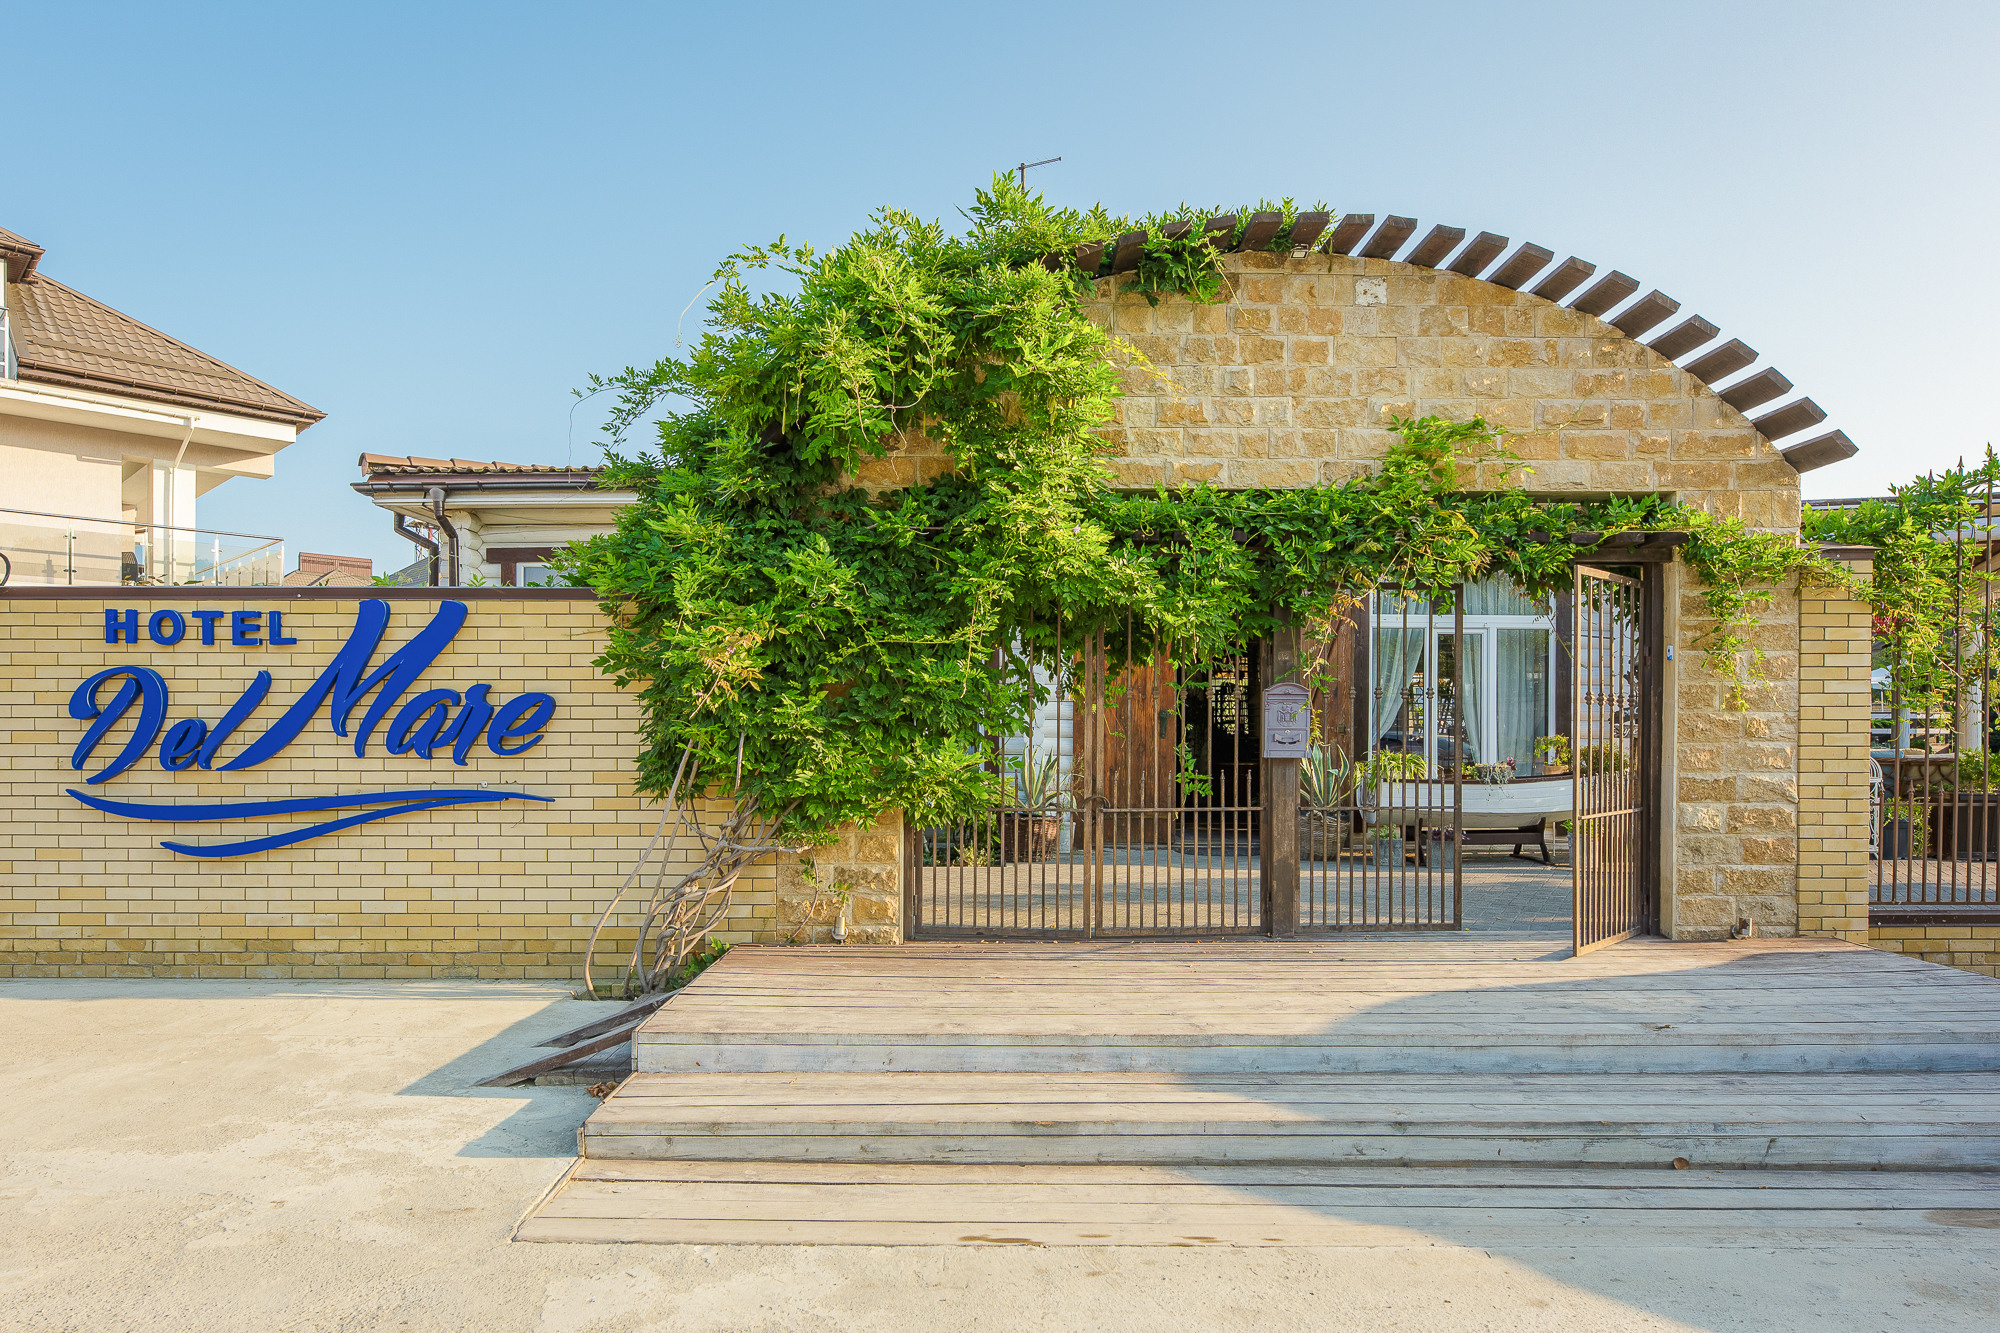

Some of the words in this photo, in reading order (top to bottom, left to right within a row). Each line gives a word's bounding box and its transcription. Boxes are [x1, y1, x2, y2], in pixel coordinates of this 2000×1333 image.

[104, 609, 297, 646] HOTEL
[68, 665, 272, 785] Del
[216, 598, 556, 772] Mare
